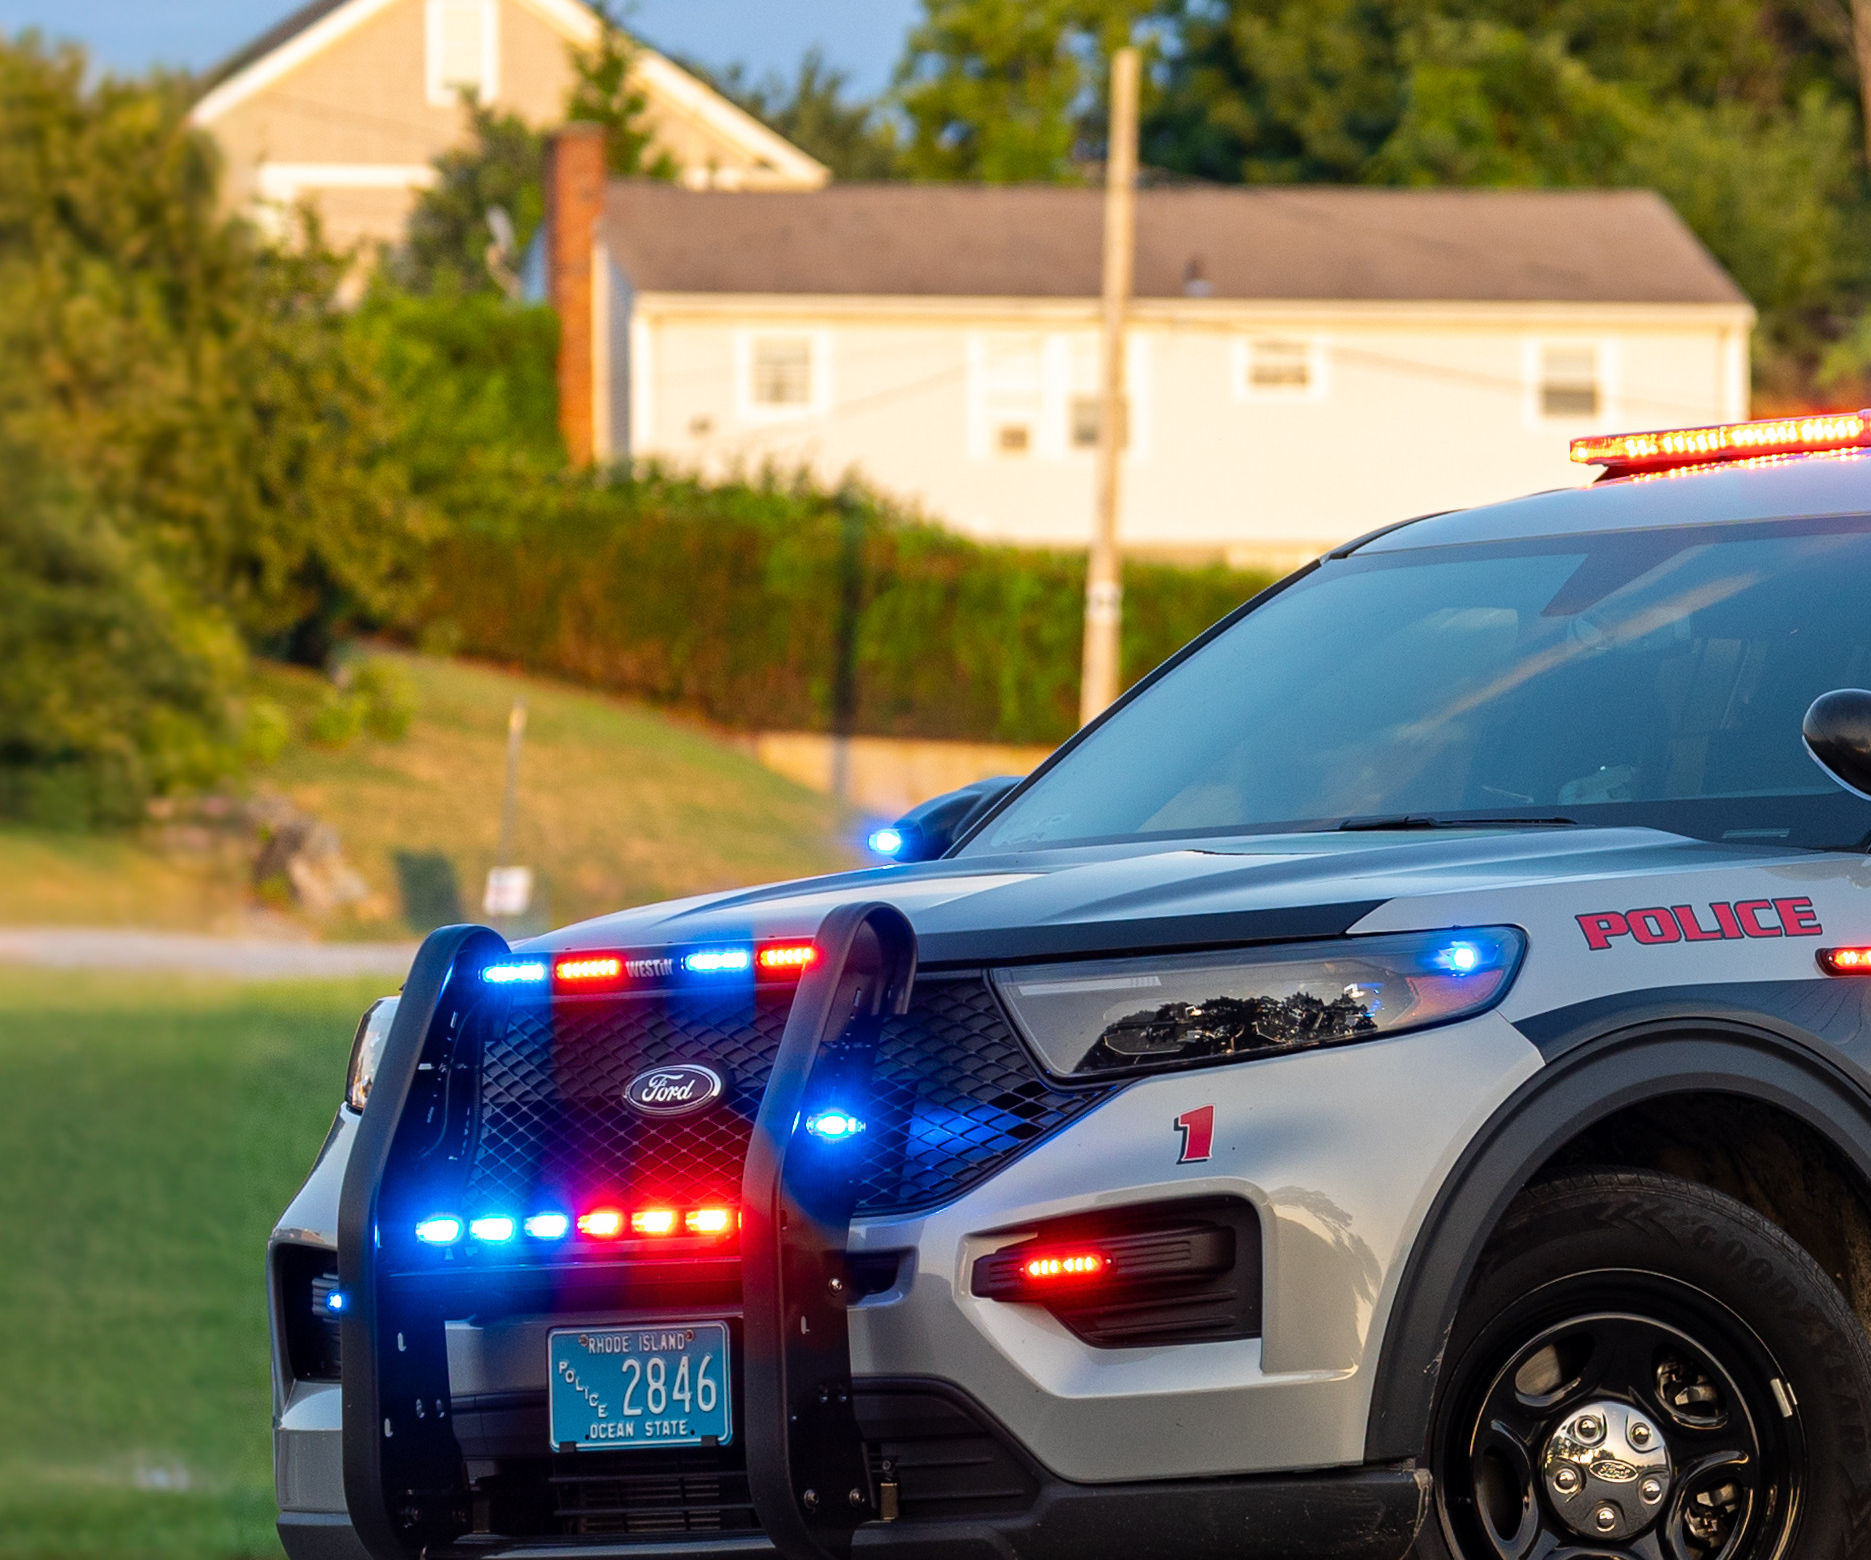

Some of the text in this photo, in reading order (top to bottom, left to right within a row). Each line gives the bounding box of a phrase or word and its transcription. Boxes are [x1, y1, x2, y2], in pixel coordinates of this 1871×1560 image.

[1575, 896, 1822, 950] POLICE
[642, 1074, 696, 1102] Ford
[1174, 1104, 1215, 1165] 1
[588, 1331, 686, 1354] RHODE ISLAND
[558, 1361, 609, 1418] POLICE
[621, 1355, 717, 1416] 2846
[589, 1419, 688, 1439] OCEAN STATE
